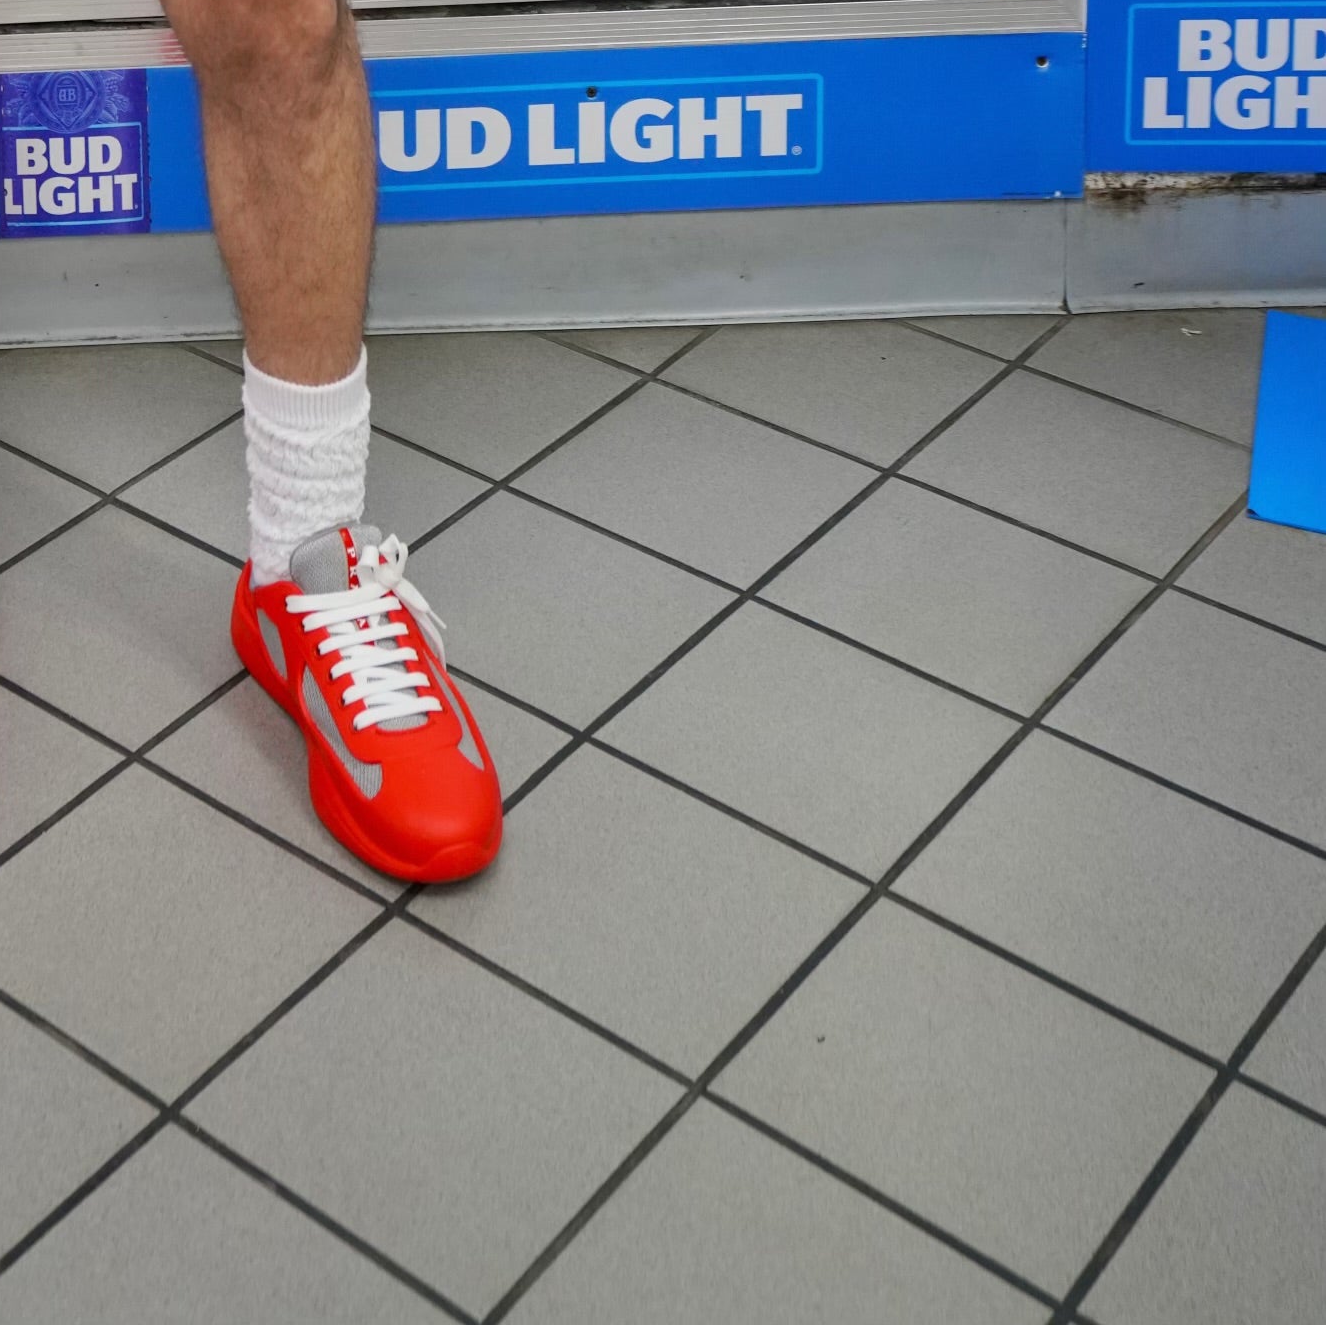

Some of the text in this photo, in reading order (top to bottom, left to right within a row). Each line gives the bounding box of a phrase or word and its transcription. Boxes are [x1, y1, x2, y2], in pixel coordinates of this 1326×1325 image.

[1178, 18, 1326, 72] BUD
[1142, 75, 1326, 130] LIGH
[15, 135, 123, 176] BUD
[379, 94, 803, 172] UD LIGHT
[4, 173, 138, 216] LIGHT
